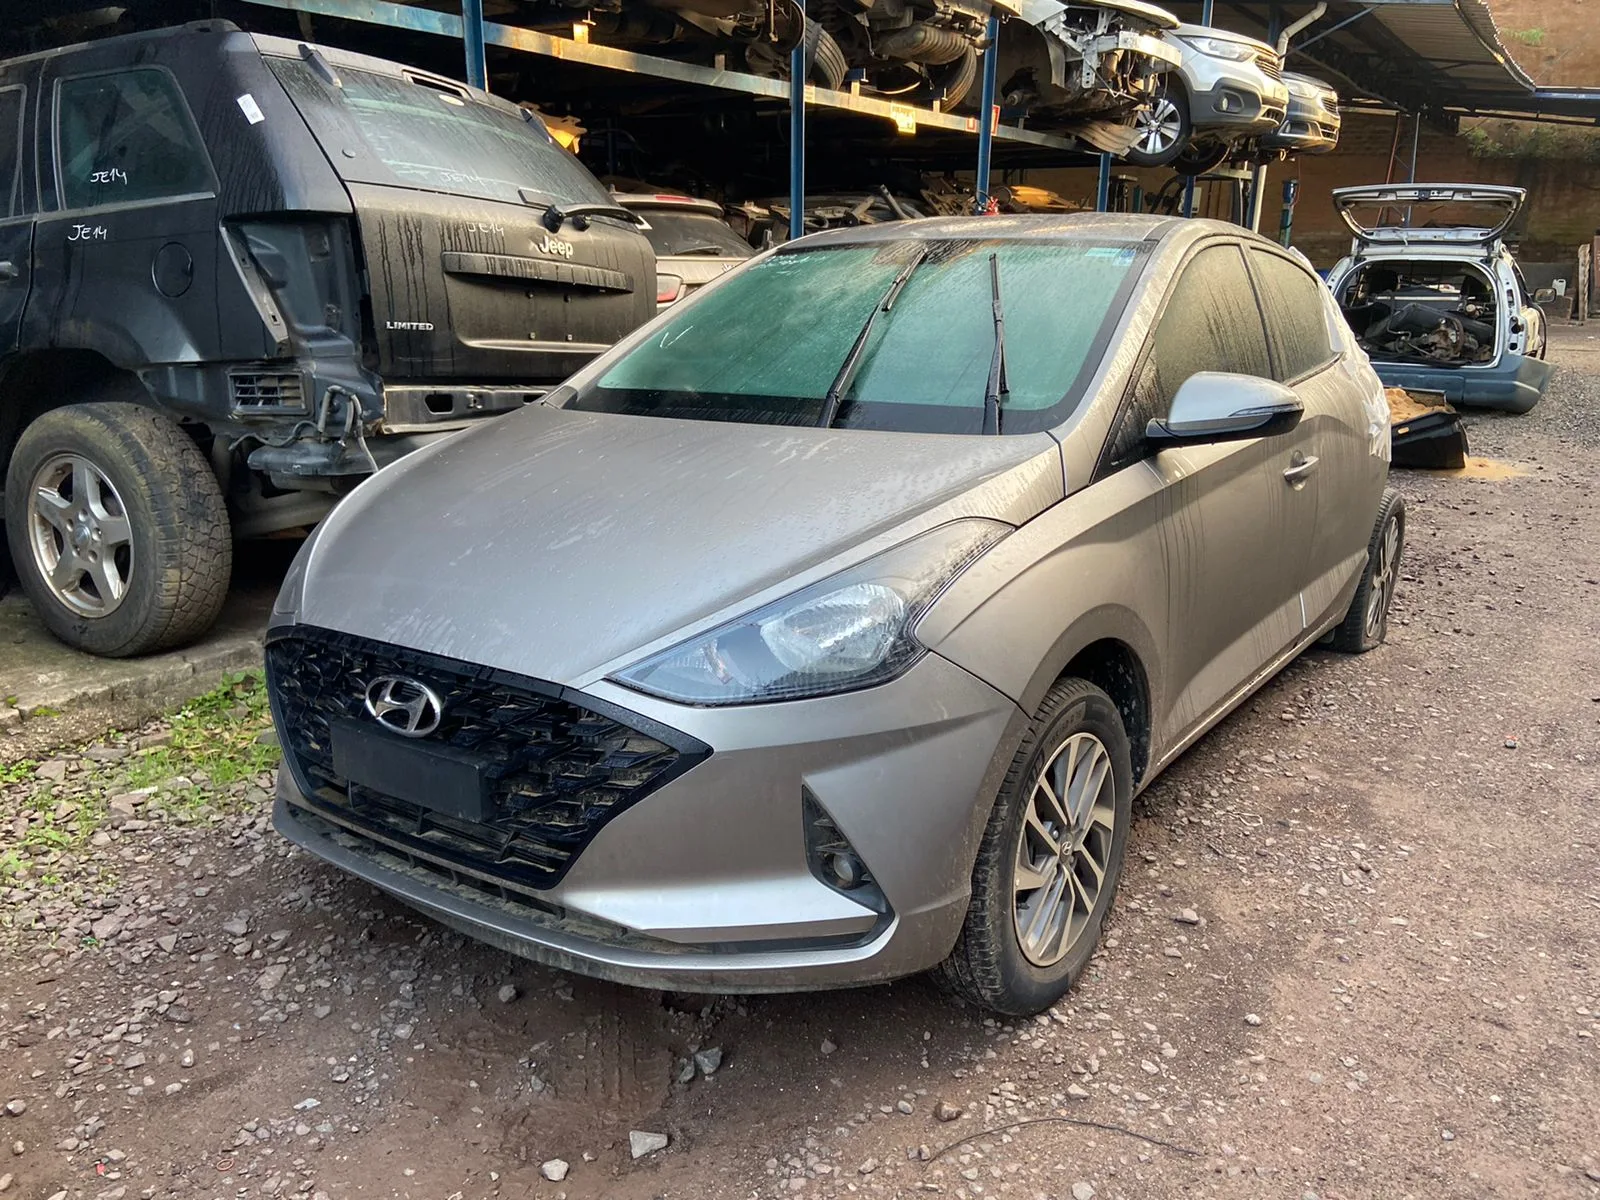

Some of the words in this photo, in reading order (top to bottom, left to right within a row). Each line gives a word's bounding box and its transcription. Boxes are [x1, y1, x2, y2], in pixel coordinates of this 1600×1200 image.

[90, 168, 128, 185] JE14
[67, 224, 107, 241] JE14
[539, 235, 574, 259] Jeep
[386, 321, 434, 331] LIMITED
